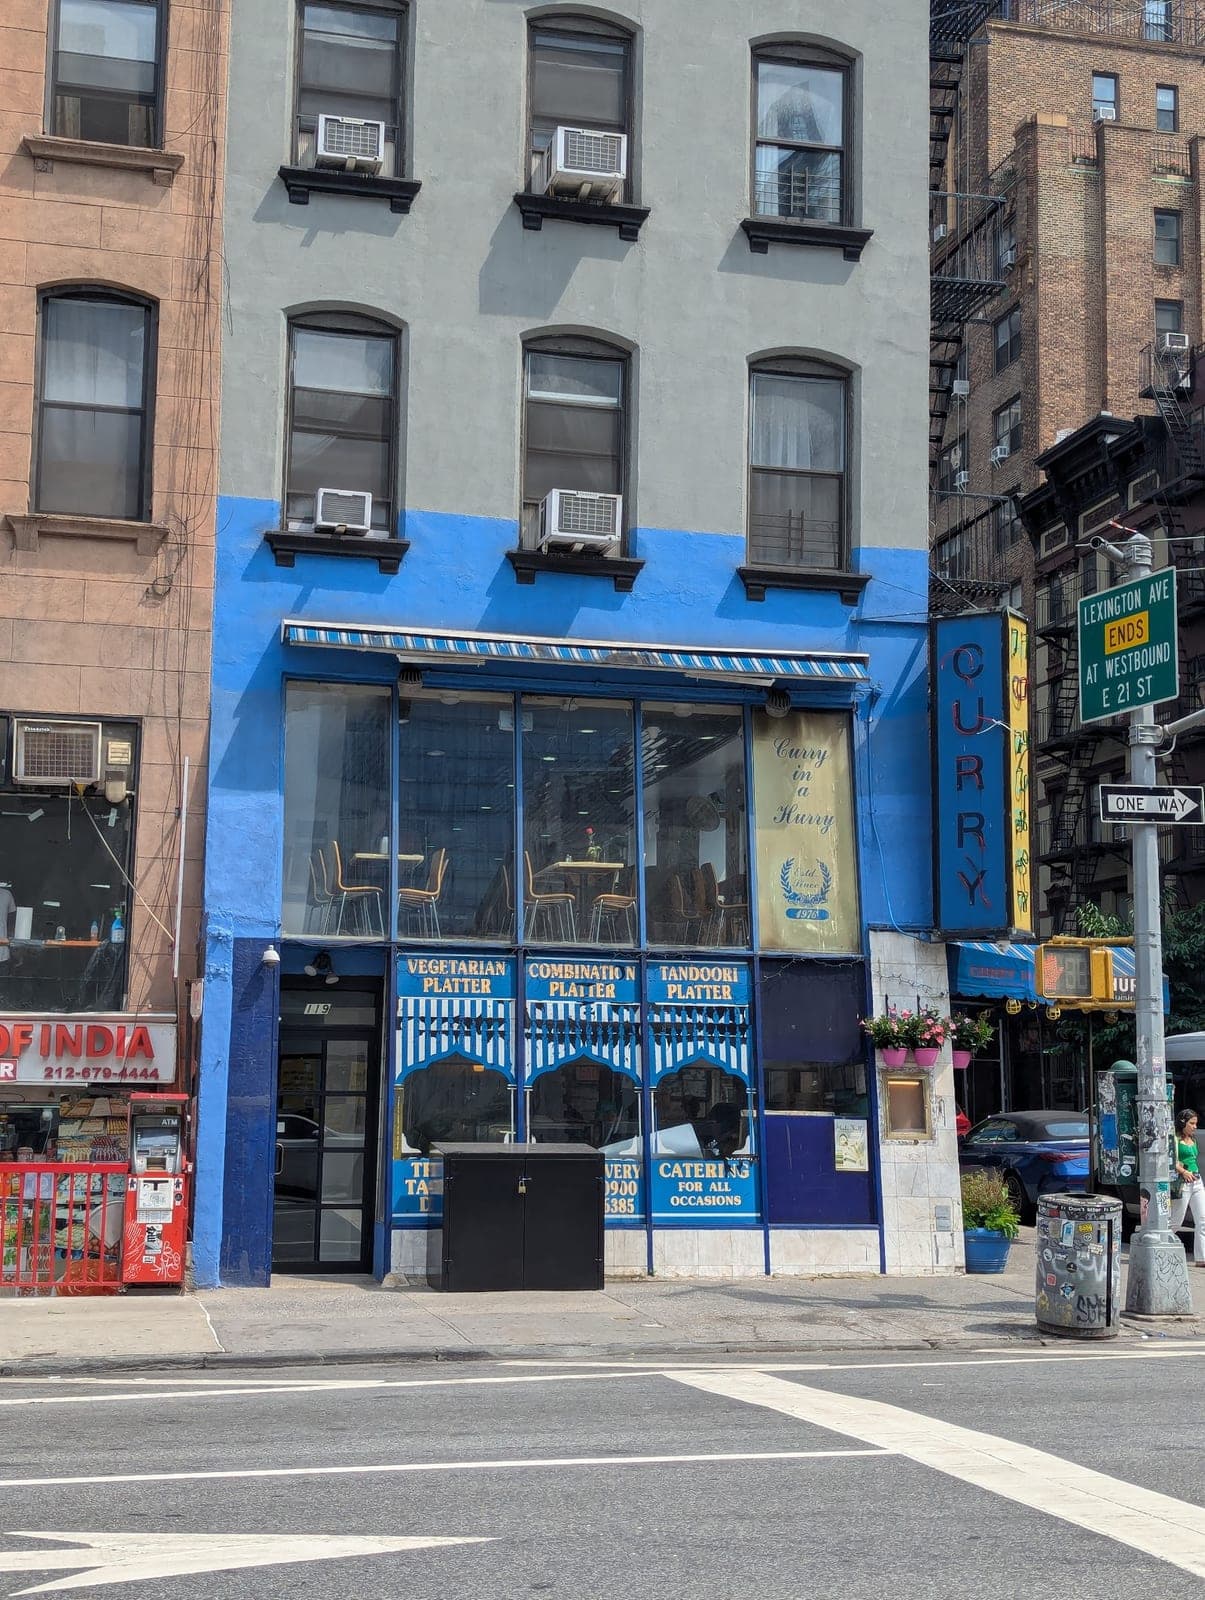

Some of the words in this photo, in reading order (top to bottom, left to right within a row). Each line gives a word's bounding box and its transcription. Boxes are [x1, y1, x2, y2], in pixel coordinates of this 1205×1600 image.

[1084, 588, 1141, 626] LEXINGTON
[1149, 578, 1169, 605] AVE
[1109, 618, 1144, 648] ENDS
[1086, 663, 1098, 685] AT
[1105, 641, 1170, 680] WESTBOUND
[1102, 687, 1110, 708] E
[1117, 681, 1130, 704] 21
[1137, 675, 1153, 698] ST
[773, 737, 828, 768] Curry
[792, 764, 812, 781] in
[952, 642, 988, 907] CURRY
[797, 786, 810, 798] a
[1116, 797, 1144, 811] ONE
[1158, 798, 1187, 812] WAY
[773, 803, 834, 834] Hurry
[407, 958, 506, 976] VEGETARIAN
[528, 962, 636, 981] COMBINATION
[659, 965, 738, 982] TANDOORI
[423, 977, 492, 994] PLATTER
[550, 981, 616, 998] PLATTER
[667, 984, 732, 1000] PLATTER
[306, 1004, 329, 1014] 119
[40, 1024, 155, 1059] INDIA
[44, 1066, 160, 1080] 212-679-4444
[161, 1118, 178, 1126] ATM
[659, 1163, 750, 1179] CATERING
[678, 1181, 703, 1192] FOR
[709, 1181, 732, 1192] ALL
[670, 1195, 742, 1207] OCCASIONS
